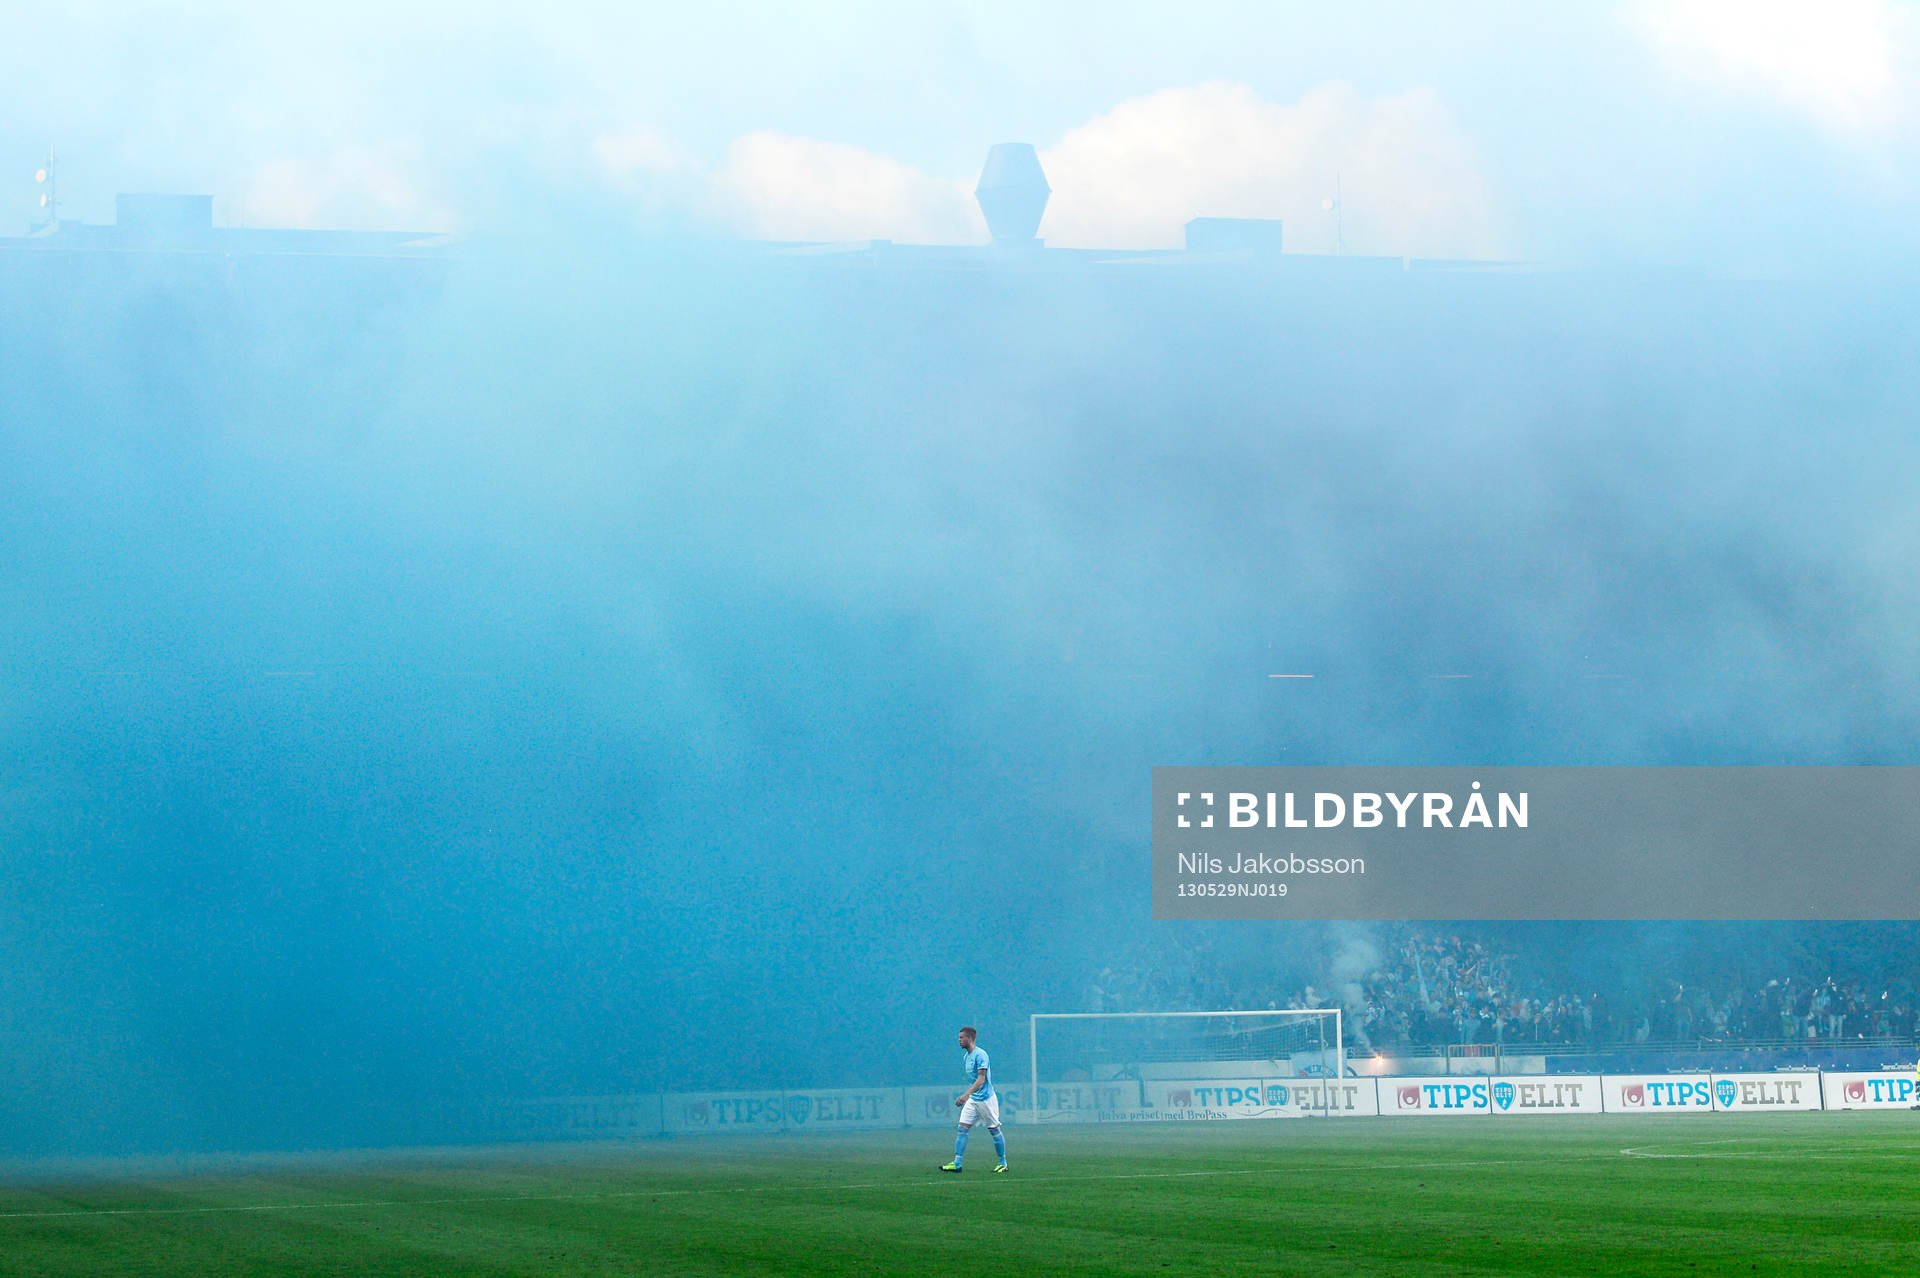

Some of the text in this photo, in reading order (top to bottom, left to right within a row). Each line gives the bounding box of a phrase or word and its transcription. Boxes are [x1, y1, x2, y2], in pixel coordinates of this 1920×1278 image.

[1194, 1086, 1261, 1107] TIPS
[1292, 1086, 1358, 1110] ELIT
[1423, 1083, 1583, 1109] TIPS ELIT
[1647, 1081, 1802, 1106] TIPS ELIT
[1867, 1078, 1915, 1102] TIP
[712, 1097, 782, 1125] TIPS
[815, 1096, 883, 1121] ELIT
